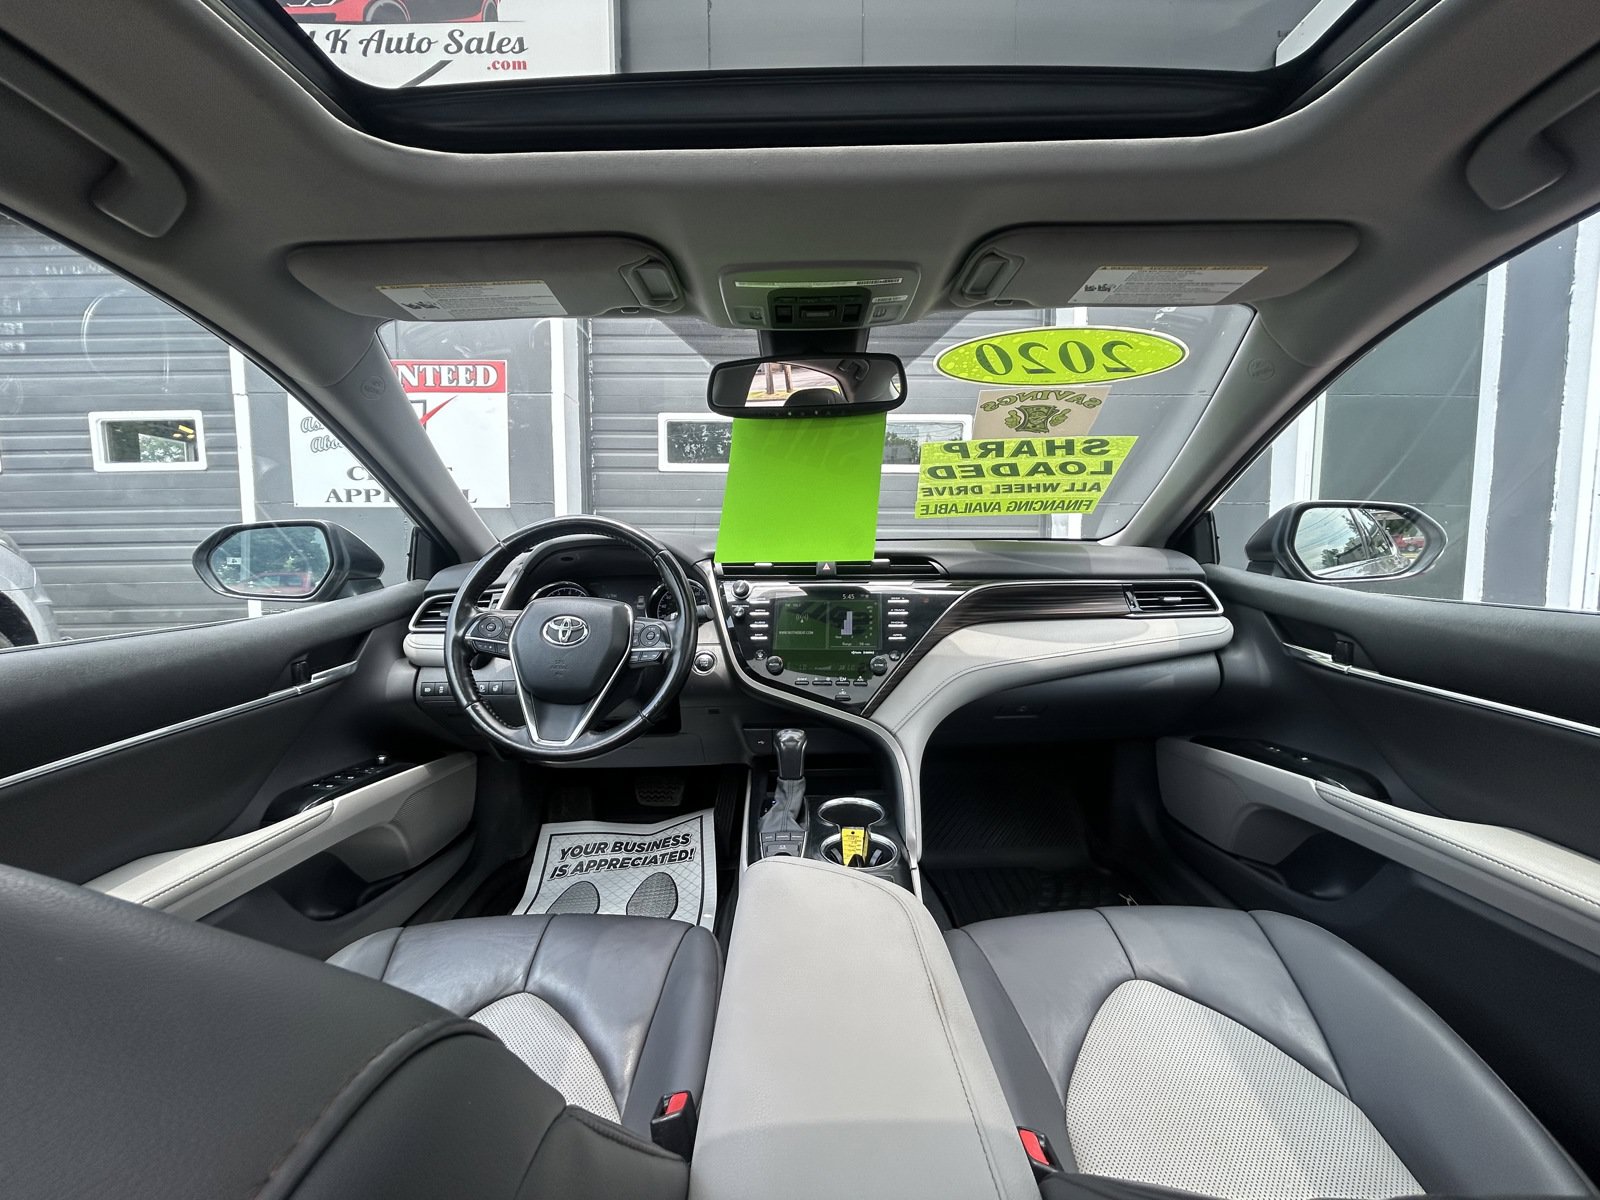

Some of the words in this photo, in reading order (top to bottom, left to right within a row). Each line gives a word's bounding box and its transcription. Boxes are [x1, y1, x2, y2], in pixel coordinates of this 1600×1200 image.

[325, 29, 351, 54] K
[358, 29, 438, 57] Auto
[443, 29, 528, 55] Sales
[486, 59, 528, 71] .com
[396, 364, 498, 387] NTEED
[300, 416, 325, 433] As
[559, 841, 609, 861] YOUR
[610, 833, 692, 854] BUSINESS
[549, 864, 570, 880] IS
[569, 848, 696, 875] APPRECIATED!
